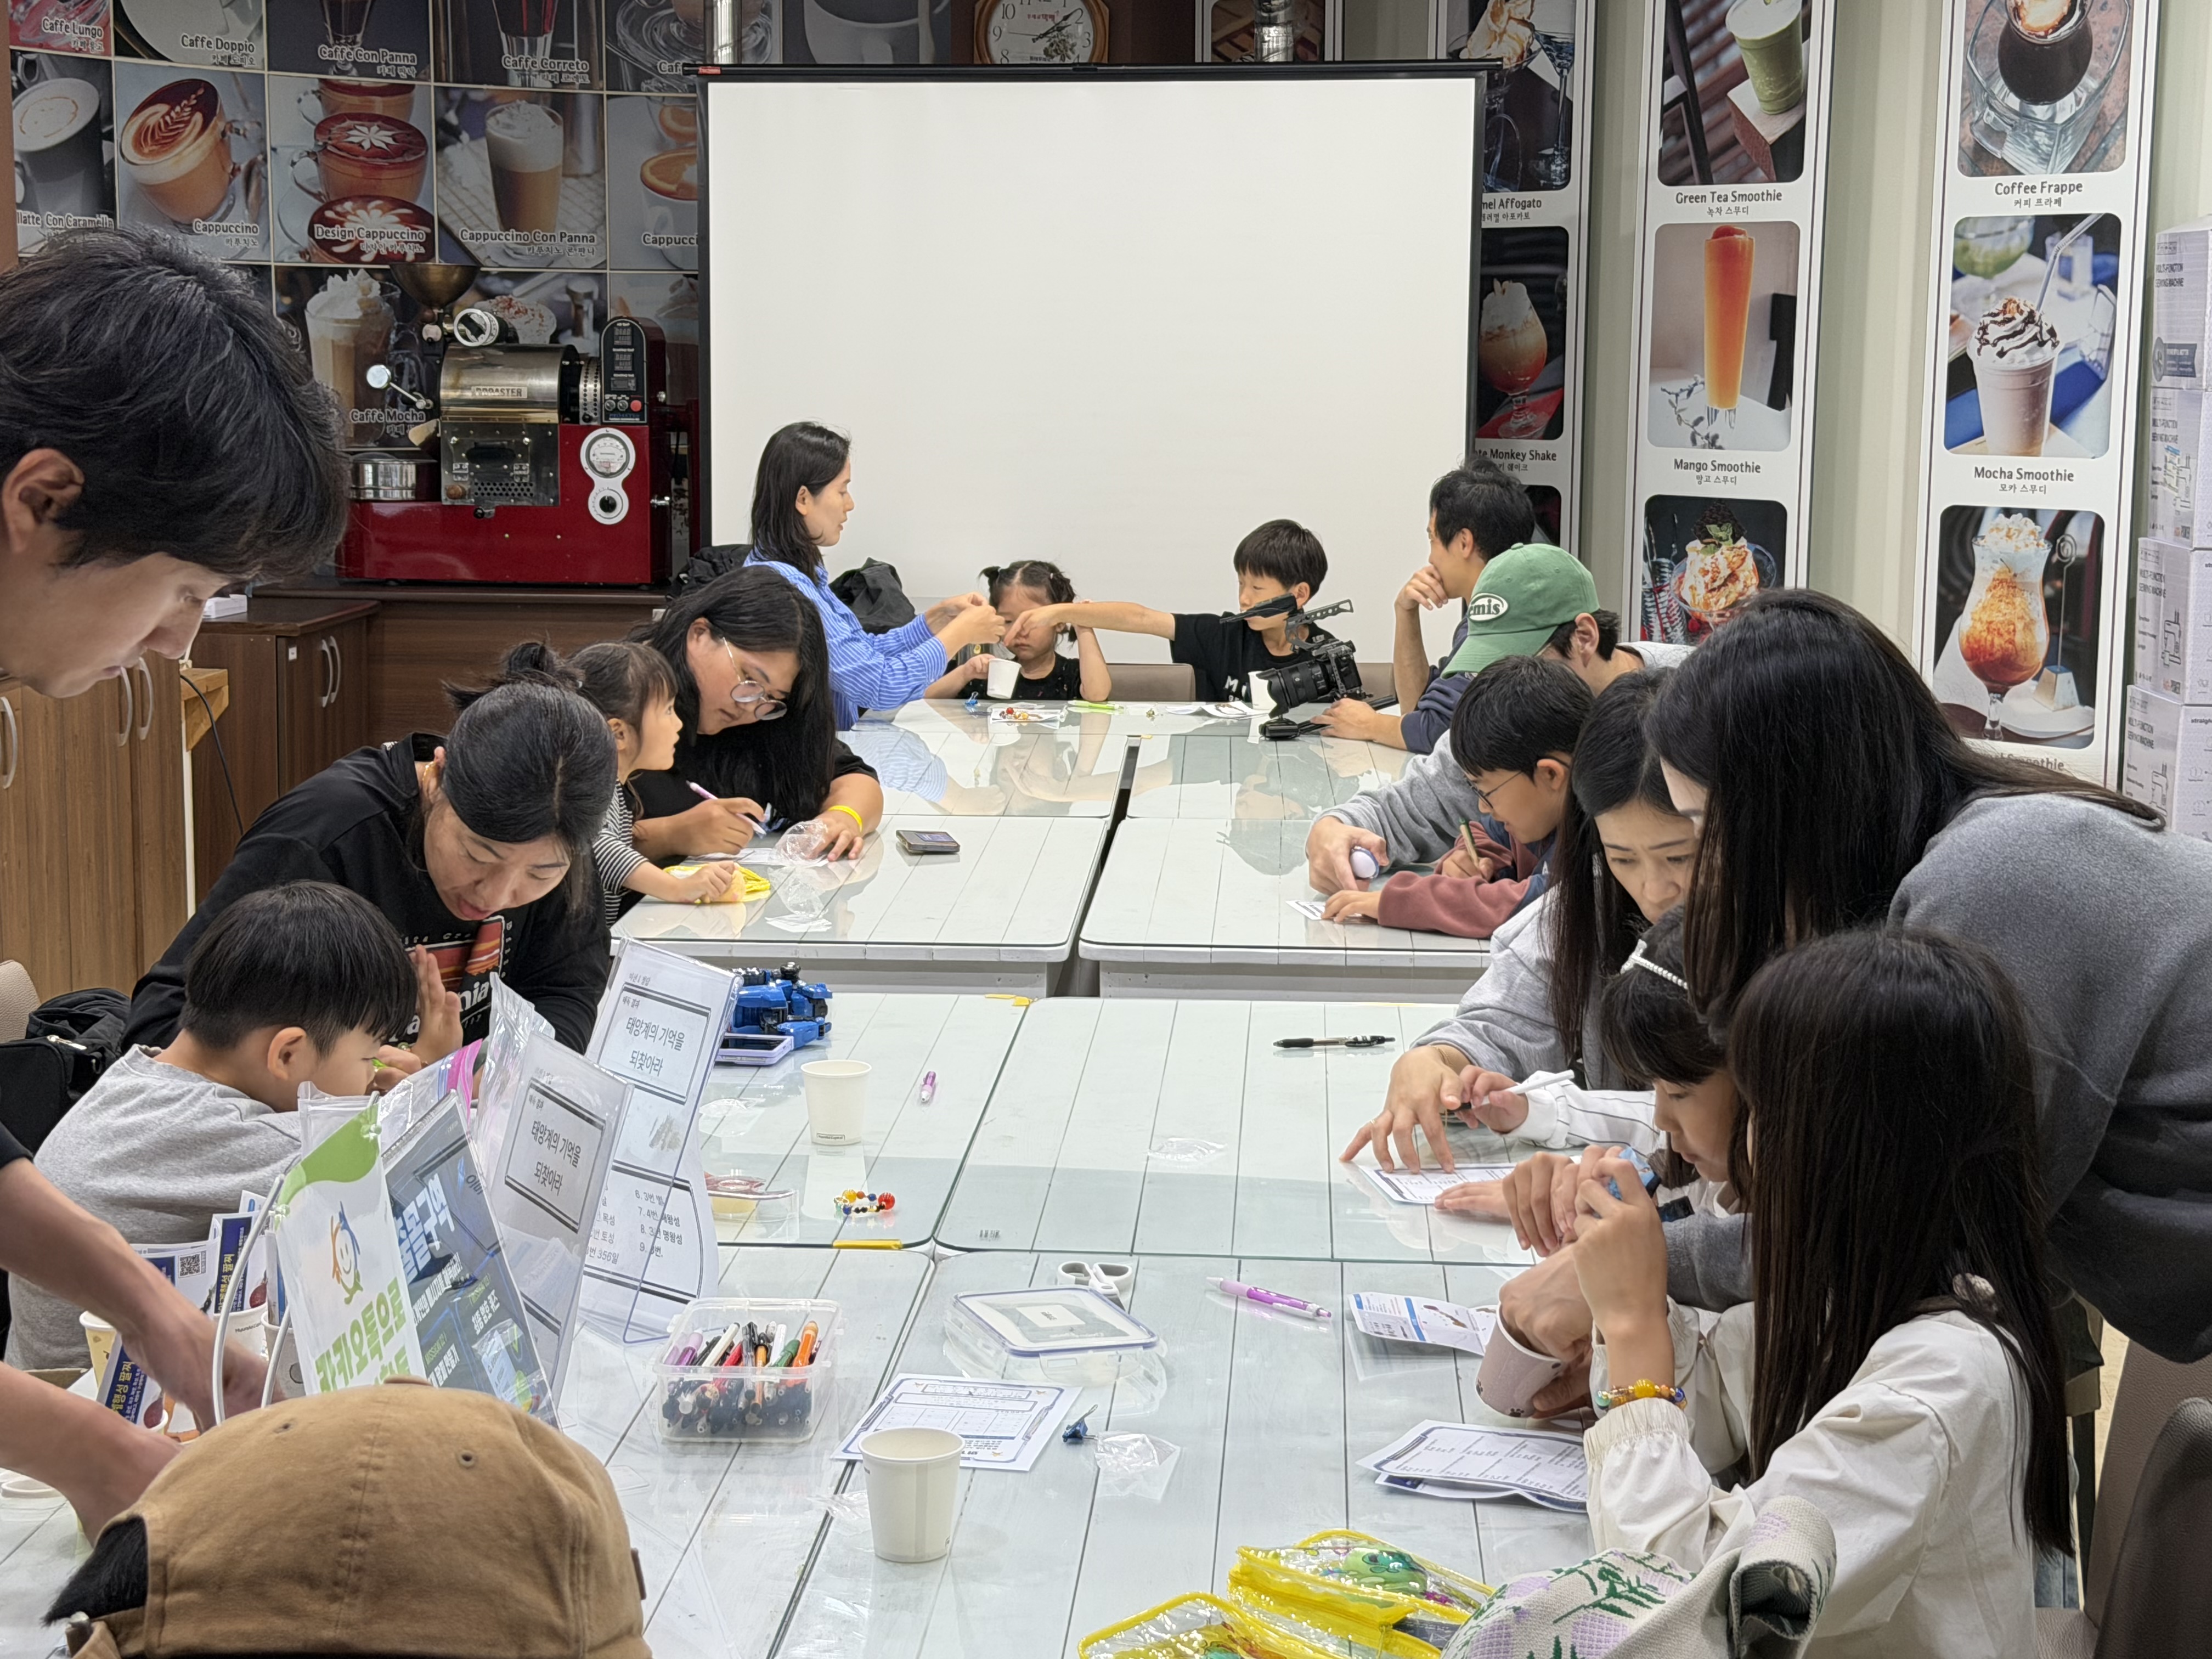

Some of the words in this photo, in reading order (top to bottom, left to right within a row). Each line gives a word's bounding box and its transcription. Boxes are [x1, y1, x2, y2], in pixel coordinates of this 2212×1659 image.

[1002, 3, 1015, 20] 10
[72, 21, 103, 38] Lungo
[992, 25, 1002, 42] 9
[215, 37, 255, 53] Doppio
[1082, 31, 1091, 48] 3
[356, 48, 378, 62] Con
[381, 50, 416, 64] Panna
[540, 58, 589, 72] Correto
[1994, 181, 2037, 195] Coffee
[2040, 180, 2084, 195] Frappe
[1498, 198, 1542, 210] Affogato
[1675, 191, 1707, 204] Green
[1709, 191, 1729, 203] Tea
[1730, 189, 1782, 202] Smoothie
[2013, 198, 2032, 209] 커피
[2034, 196, 2062, 208] 프라페
[16, 211, 41, 225] llatte
[46, 213, 64, 227] Con
[1706, 206, 1723, 218] 녹차
[1725, 205, 1749, 216] 스무디
[194, 220, 258, 235] Cappuccino
[315, 225, 354, 240] Design
[357, 227, 425, 241] Cappuccino
[460, 228, 529, 243] Cappuccino
[533, 230, 556, 243] Con
[559, 231, 595, 244] Panna
[386, 409, 425, 421] Mocha
[1489, 448, 1527, 462] Monkey
[1528, 449, 1557, 461] Shake
[1673, 458, 1708, 473] Mango
[1710, 460, 1762, 473] Smoothie
[1696, 474, 1711, 486] 망고
[1713, 475, 1737, 486] 스무디
[1974, 466, 2013, 480] Mocha
[2016, 467, 2075, 482] Smoothie
[1999, 483, 2017, 494] 모카
[2019, 484, 2047, 495] 스무디
[625, 1017, 659, 1043] 태양계의
[658, 1027, 685, 1052] 기억을
[629, 1050, 664, 1077] 되찾아라
[531, 1120, 561, 1155] 태양계의
[559, 1138, 582, 1168] 기억을
[534, 1161, 563, 1197] 되찾아라
[635, 1189, 642, 1200] 6.
[643, 1192, 655, 1204] 3번
[603, 1212, 616, 1227] 목성
[637, 1206, 646, 1217] 7.
[646, 1209, 659, 1221] 4번
[601, 1230, 615, 1244] 토성
[640, 1224, 647, 1234] 8.
[663, 1229, 682, 1245] 명왕성
[640, 1242, 647, 1252] 9.
[222, 1253, 235, 1274] 팔찌
[597, 1249, 619, 1265] 356일
[471, 1313, 484, 1335] 최종
[479, 1300, 492, 1324] 암호
[488, 1289, 500, 1313] 퀴즈
[316, 1276, 407, 1393] 카카오톡으로
[443, 1342, 460, 1375] 만들기
[119, 1361, 135, 1382] 팔찌
